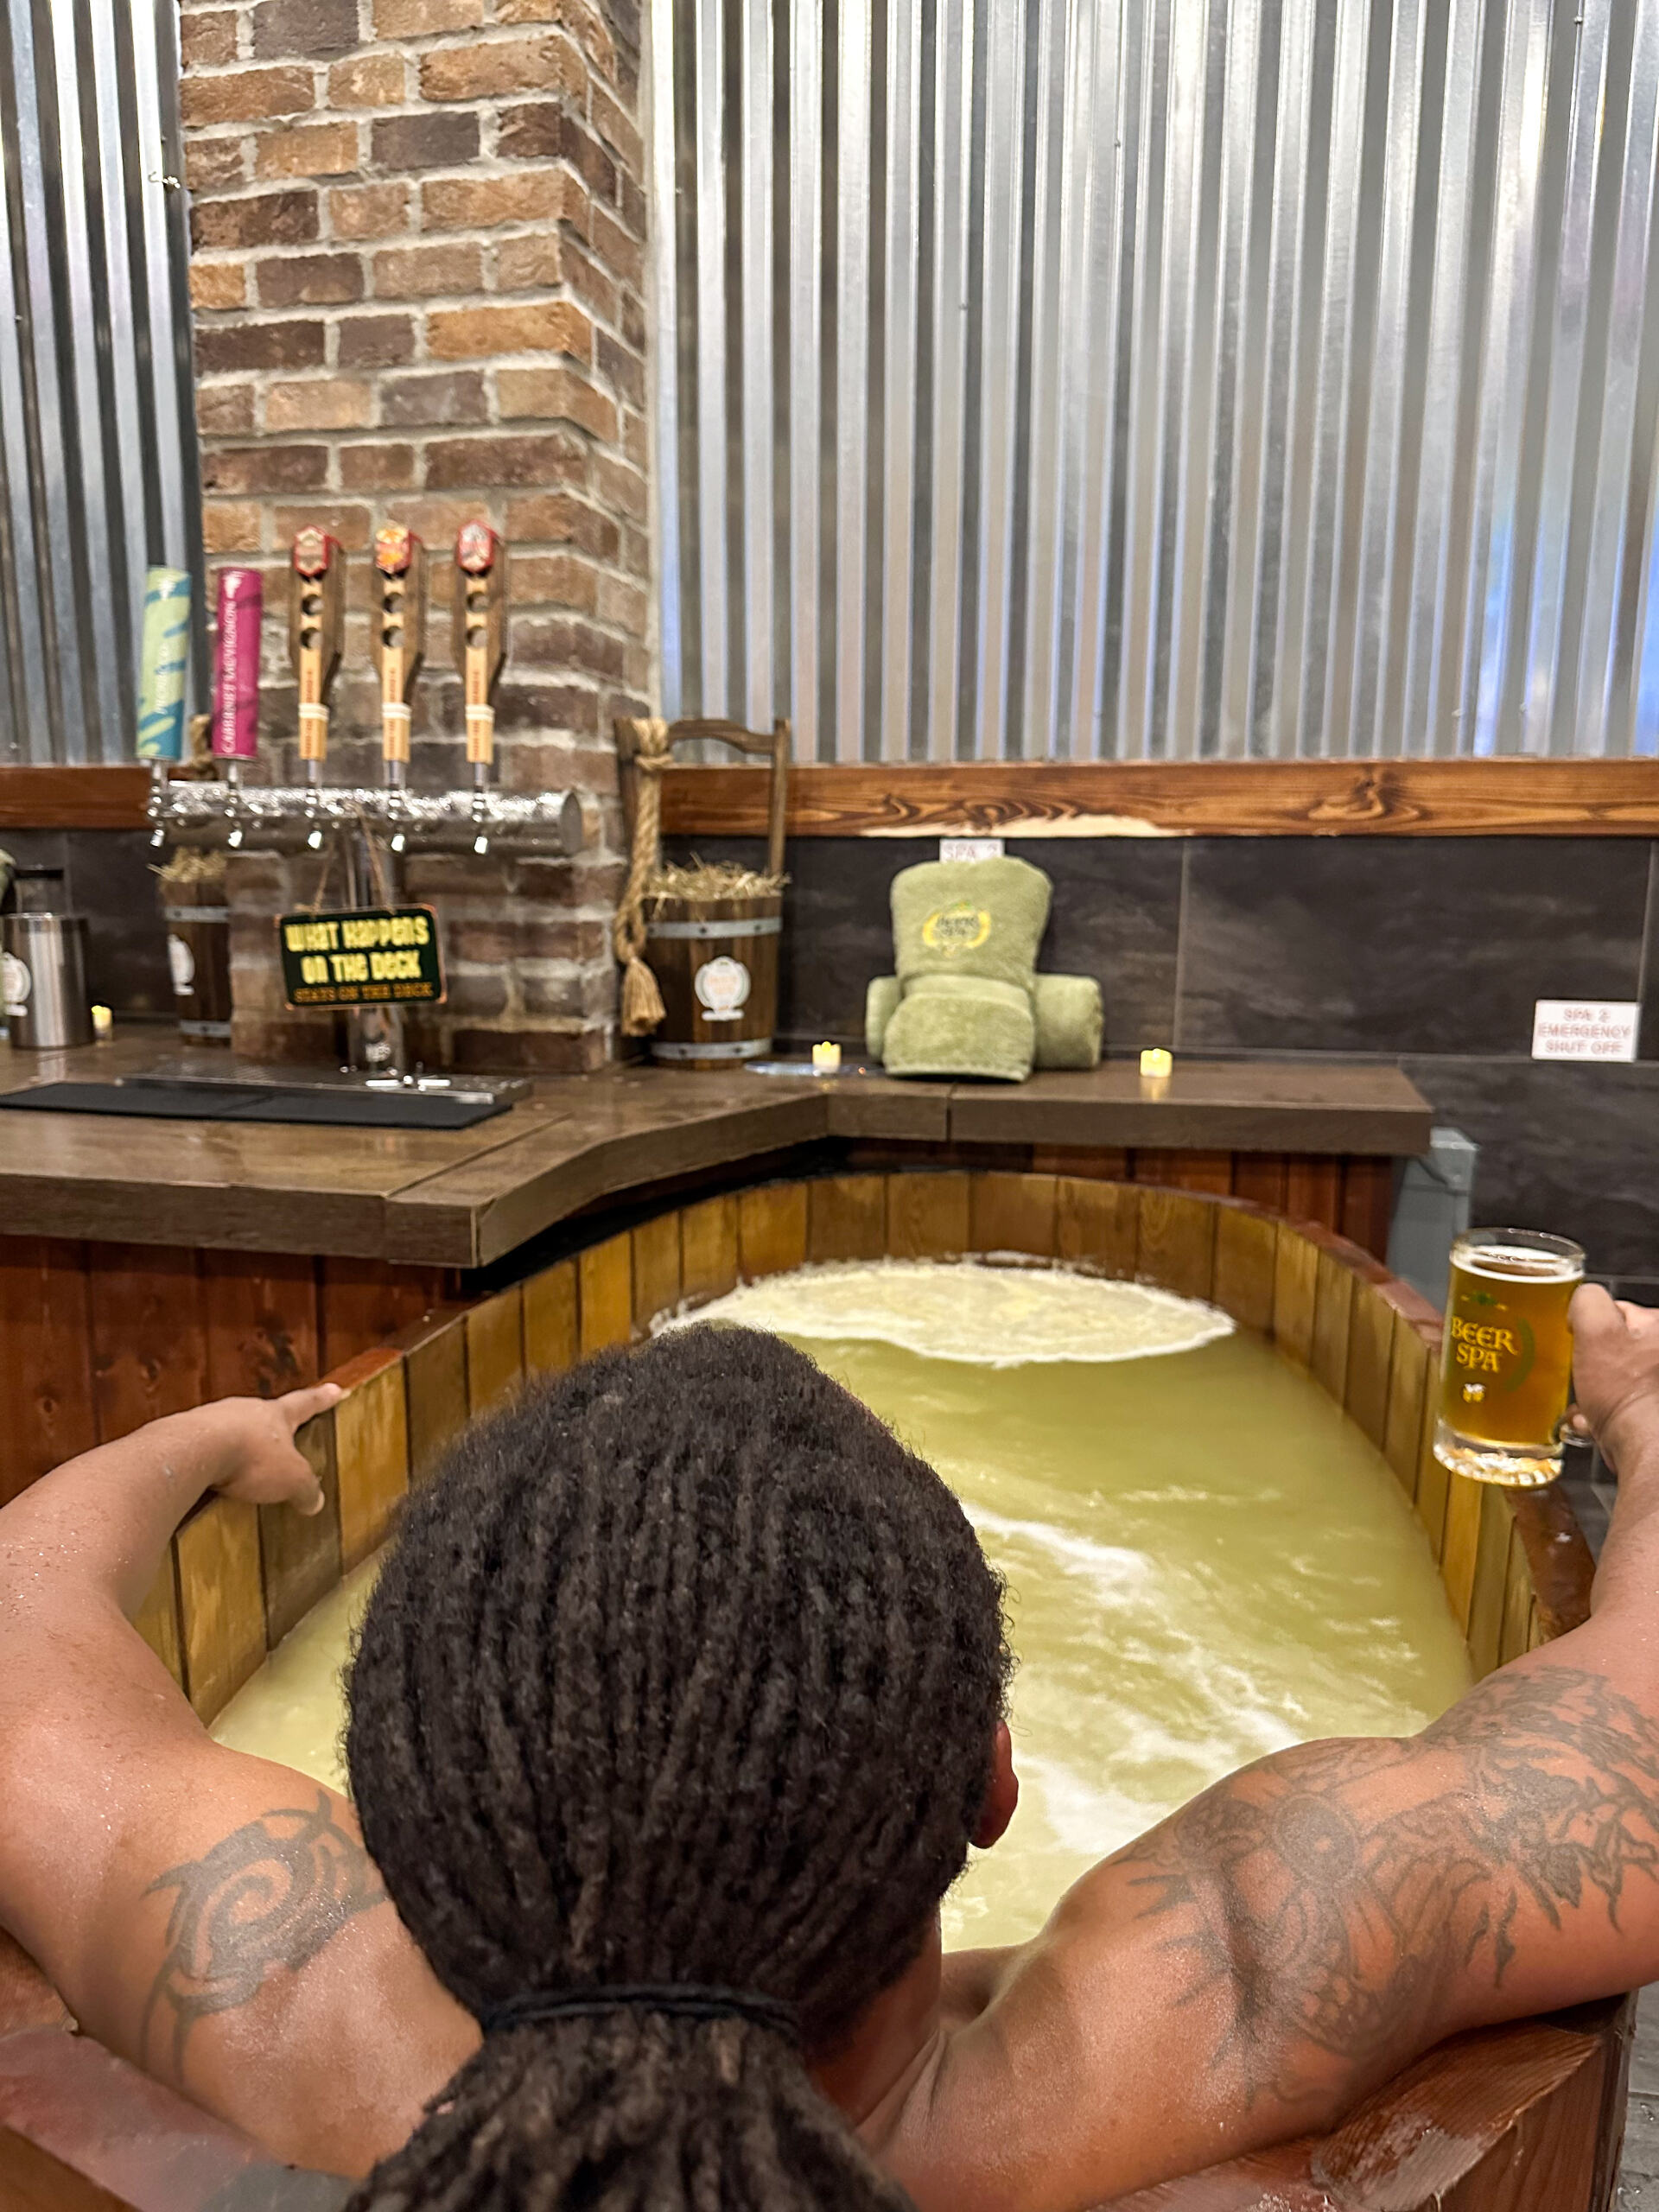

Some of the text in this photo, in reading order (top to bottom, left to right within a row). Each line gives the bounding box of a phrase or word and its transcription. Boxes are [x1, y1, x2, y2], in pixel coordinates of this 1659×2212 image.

[285, 915, 430, 952] WHAT HAPPENS
[301, 955, 329, 984] ON
[329, 952, 369, 982] THE
[1563, 1007, 1611, 1022] SPA 2
[1538, 1023, 1632, 1039] EMERGENCY
[1545, 1039, 1624, 1054] SHUT OFF
[1452, 1314, 1517, 1355] BEER
[1456, 1343, 1503, 1373] SPA
